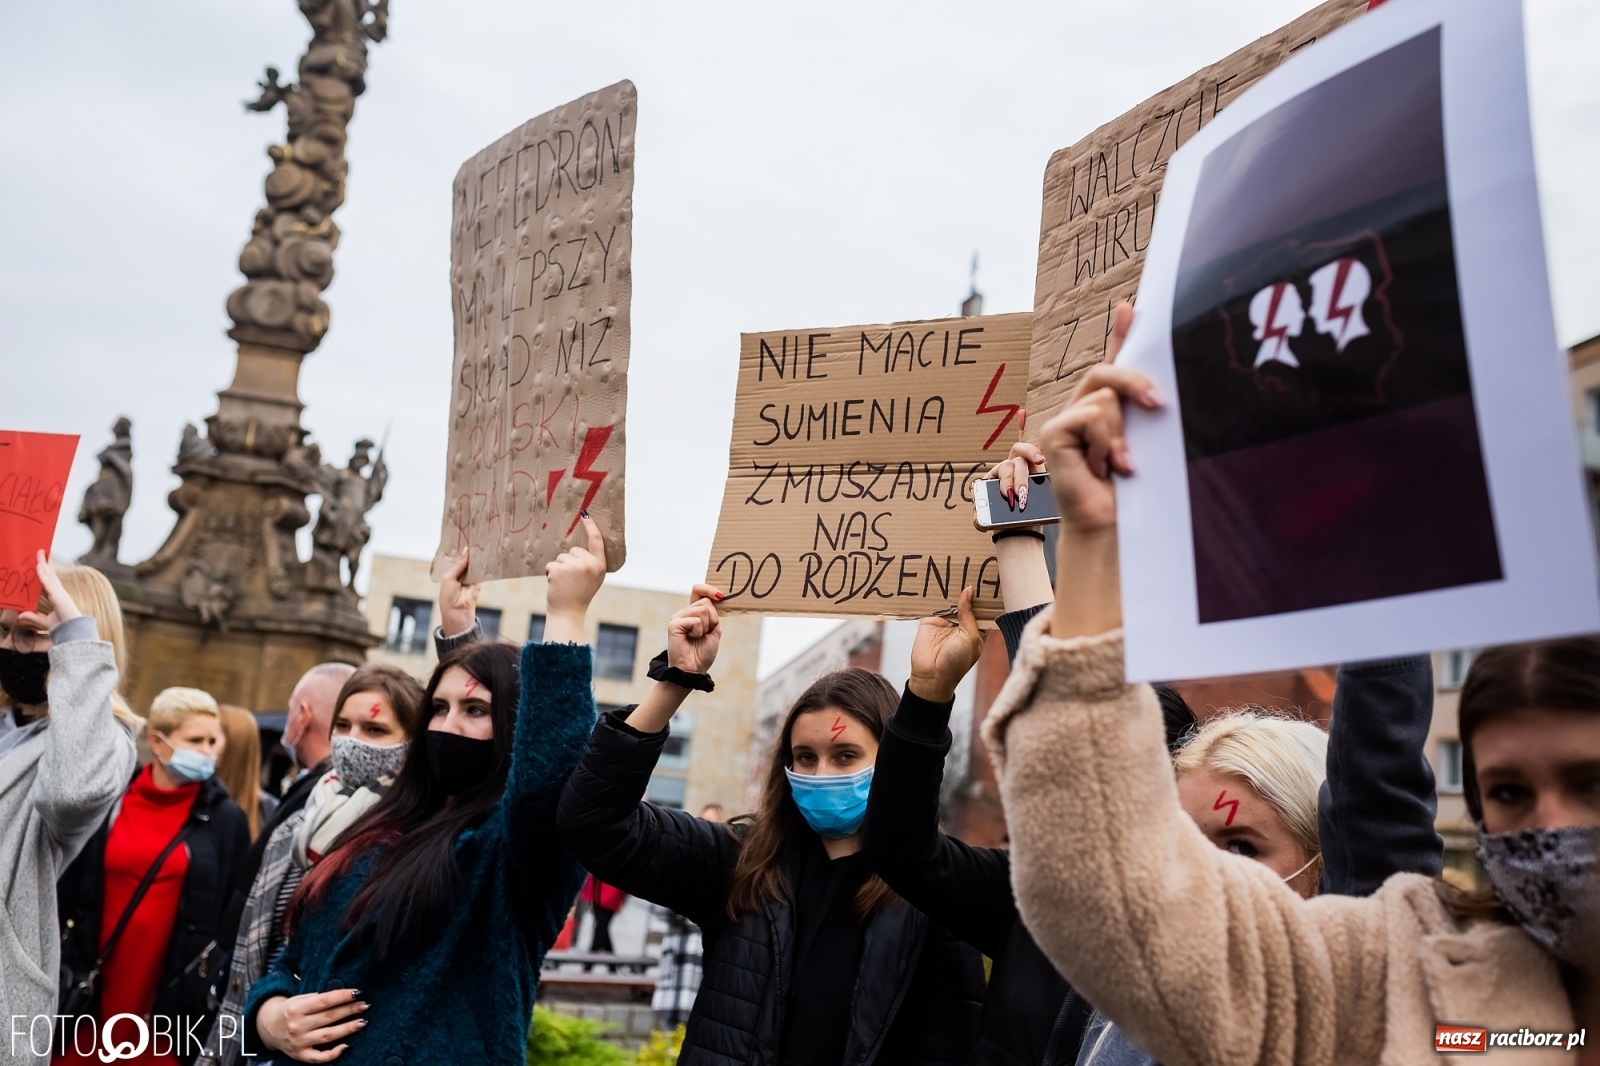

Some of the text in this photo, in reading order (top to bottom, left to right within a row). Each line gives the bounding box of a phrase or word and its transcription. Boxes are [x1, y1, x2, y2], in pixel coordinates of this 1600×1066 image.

[1074, 193, 1156, 286] WIRU
[459, 226, 616, 340] MA LEPSZY
[459, 308, 612, 419] SKŁAD NIŻ
[758, 327, 985, 381] NIE MACIE
[470, 391, 580, 470] POLSKI
[753, 395, 945, 446] SUMIENIA
[813, 510, 893, 551] NAS
[716, 551, 1000, 605] DO RODZENIA
